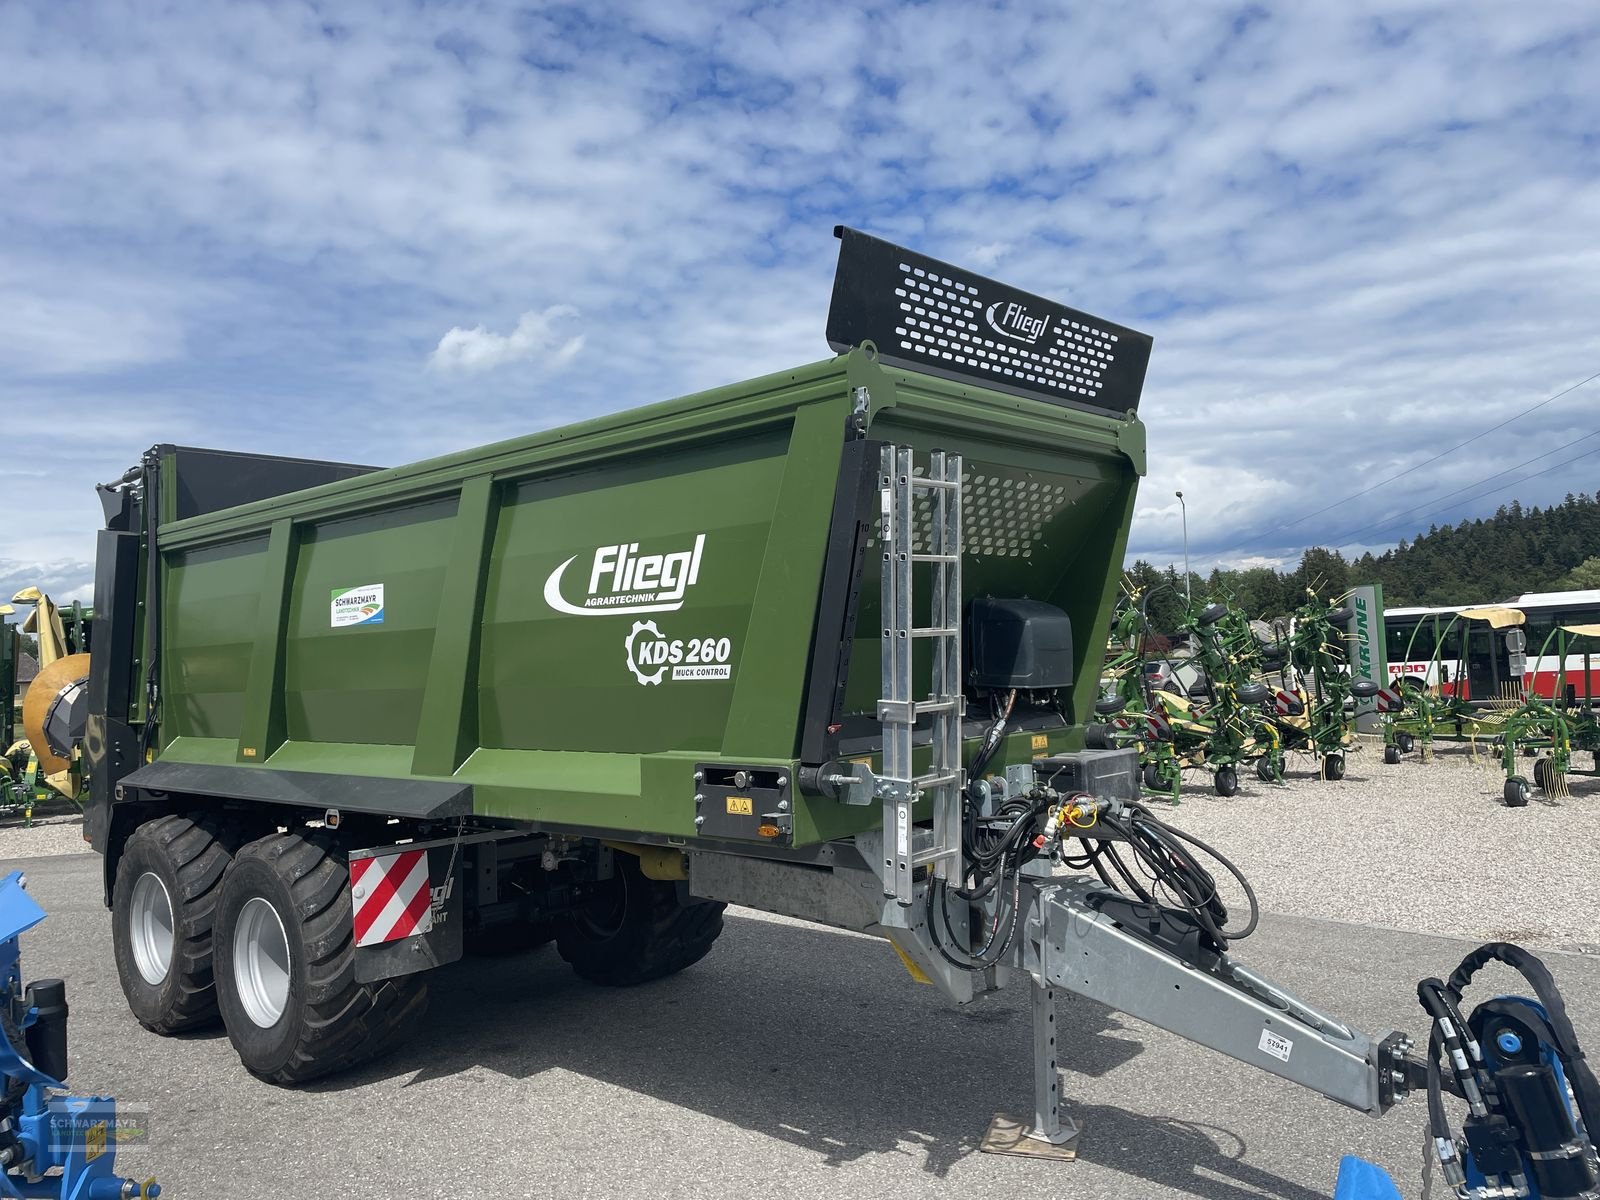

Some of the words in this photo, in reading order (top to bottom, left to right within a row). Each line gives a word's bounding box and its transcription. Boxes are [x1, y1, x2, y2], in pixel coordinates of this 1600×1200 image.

[1002, 302, 1050, 339] Fliegl
[860, 523, 869, 533] 10
[588, 533, 706, 602] Fliegl
[335, 594, 376, 606] SCHWARZMAYR
[584, 592, 655, 607] AGRARTECHNIK
[1355, 597, 1371, 679] KRONE
[638, 640, 683, 664] KDS
[685, 637, 731, 662] 260
[675, 668, 694, 677] MUCK
[697, 667, 728, 676] CONTROL
